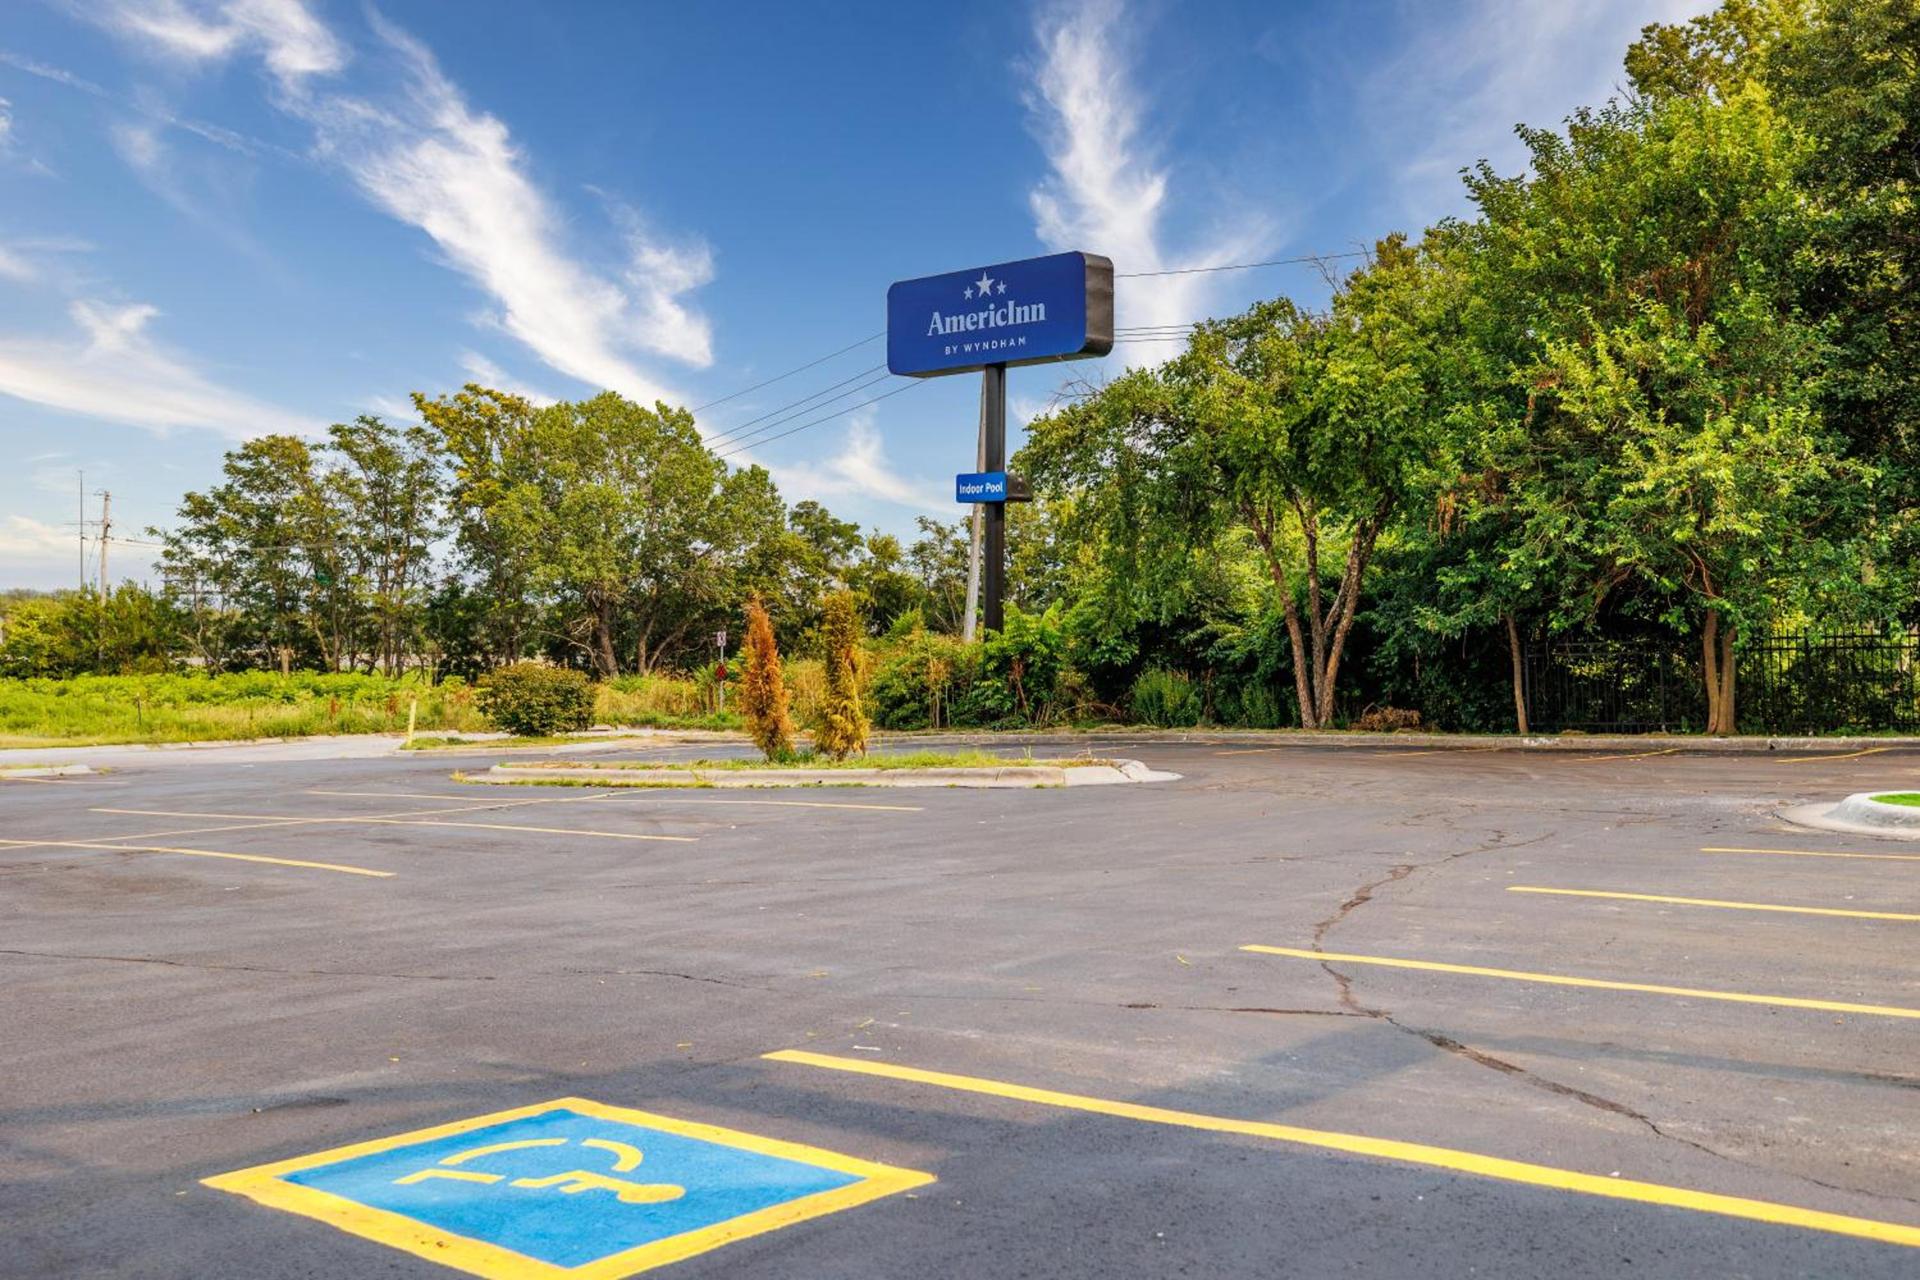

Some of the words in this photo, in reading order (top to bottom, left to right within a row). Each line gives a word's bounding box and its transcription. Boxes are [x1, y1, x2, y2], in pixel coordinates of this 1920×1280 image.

[927, 300, 1046, 336] AmericInn
[945, 345, 958, 355] BY
[964, 337, 1026, 352] WYNDHAM
[960, 483, 983, 494] Indoor
[985, 482, 1003, 492] Pool
